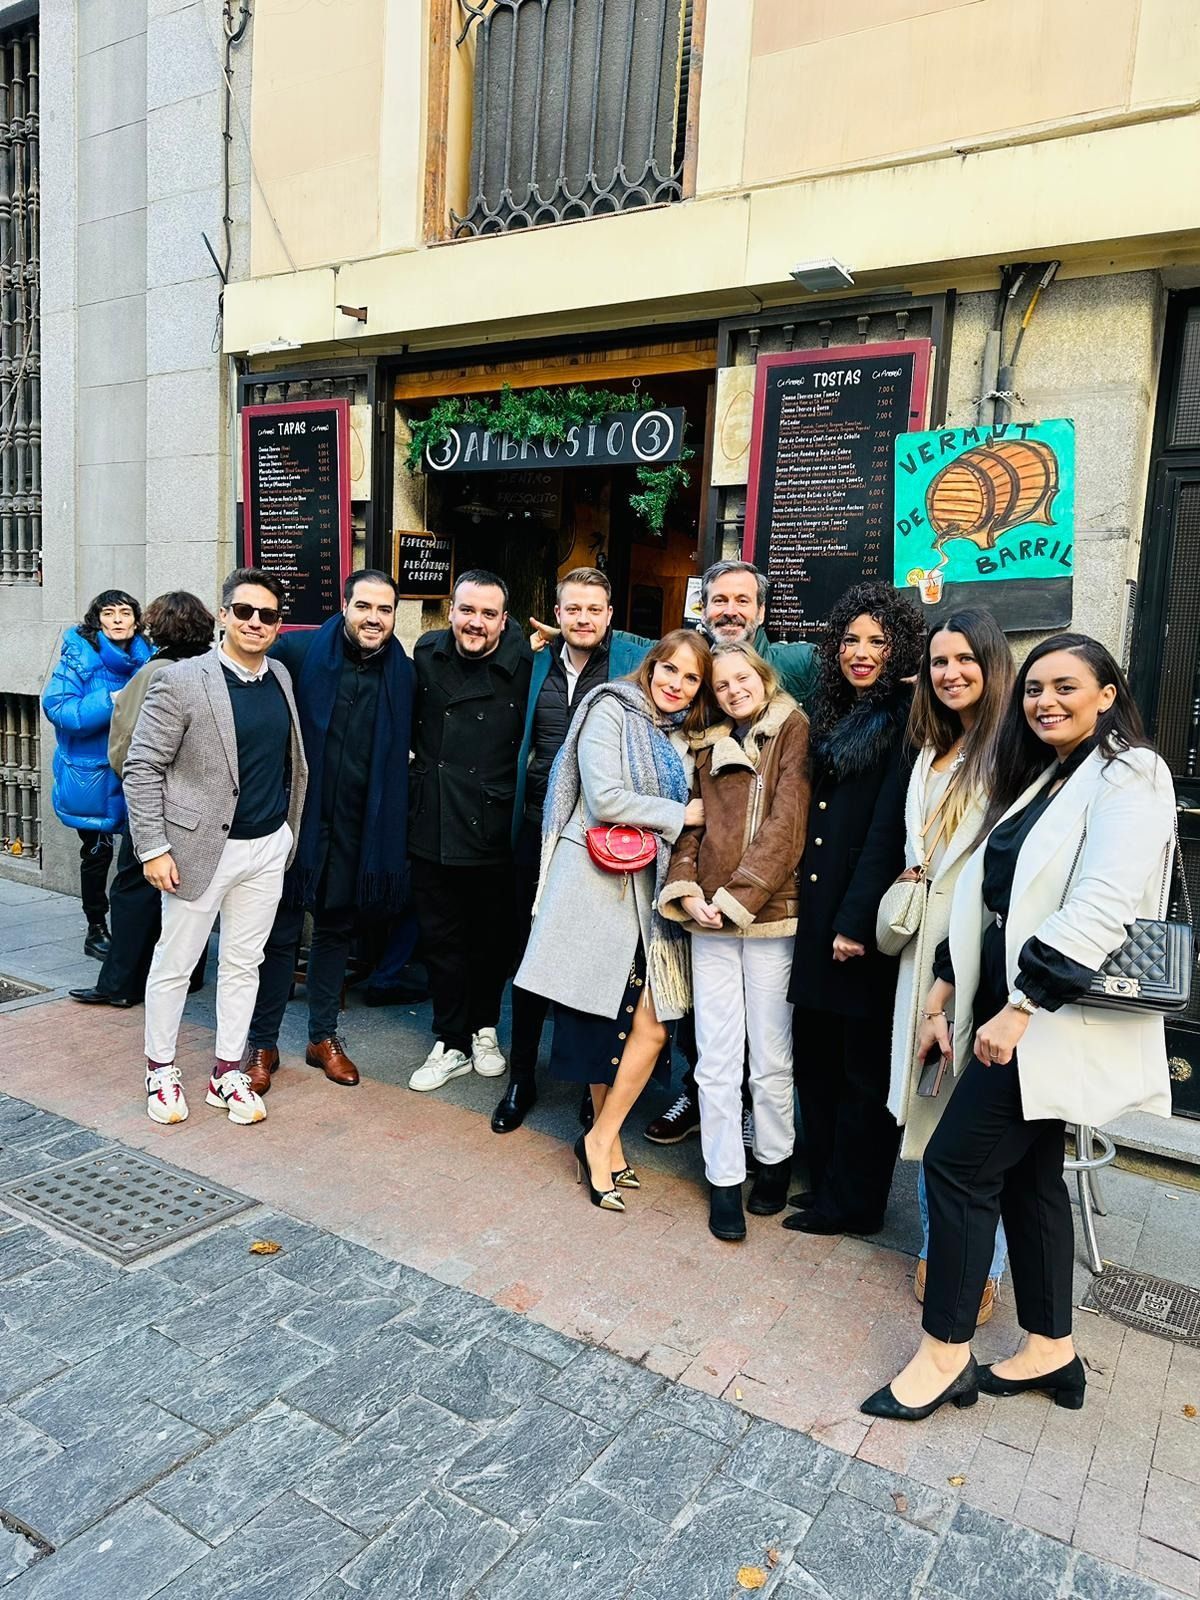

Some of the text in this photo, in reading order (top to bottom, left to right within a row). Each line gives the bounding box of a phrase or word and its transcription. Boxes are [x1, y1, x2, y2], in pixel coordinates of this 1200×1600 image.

[813, 369, 861, 388] TOSTAS
[278, 421, 306, 436] TAPAS
[898, 423, 1034, 475] VERMUT
[896, 507, 925, 536] DE
[976, 538, 1072, 574] BARRIL
